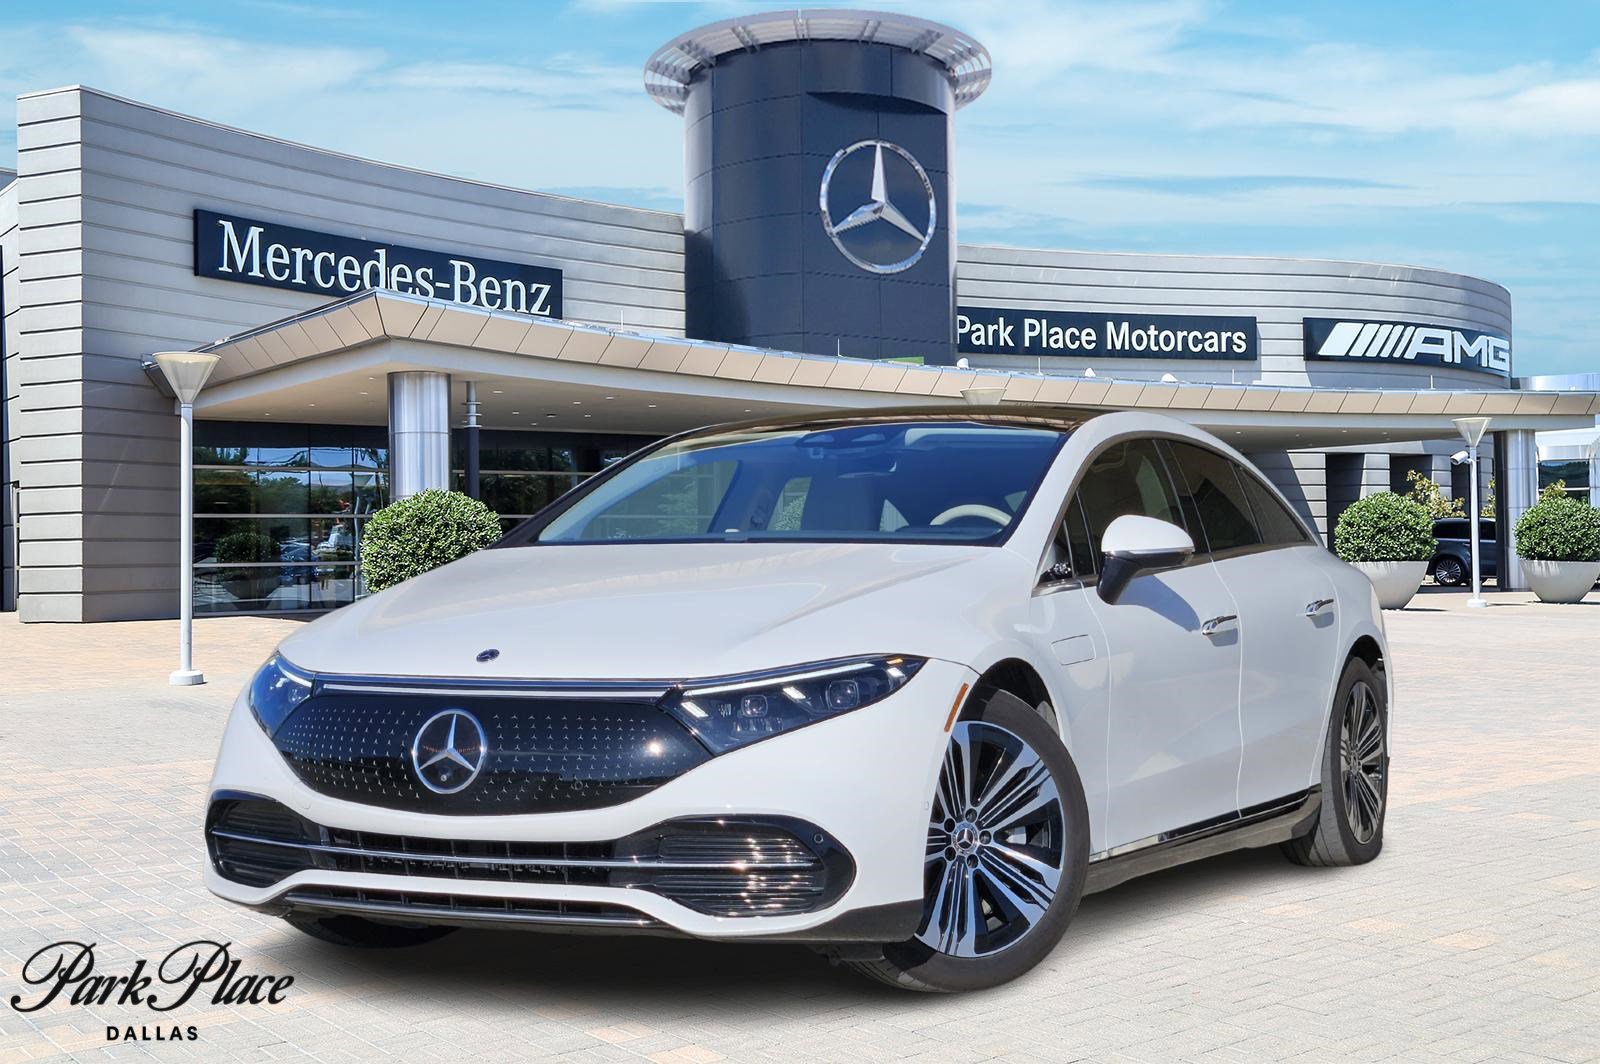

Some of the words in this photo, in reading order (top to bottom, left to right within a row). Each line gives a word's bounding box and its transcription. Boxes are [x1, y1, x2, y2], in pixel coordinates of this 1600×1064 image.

[218, 219, 551, 316] Mercedes-Benz
[957, 315, 1015, 348] Park
[1023, 318, 1097, 350] Place
[1106, 321, 1248, 354] Motorcars
[1404, 326, 1510, 372] AMG
